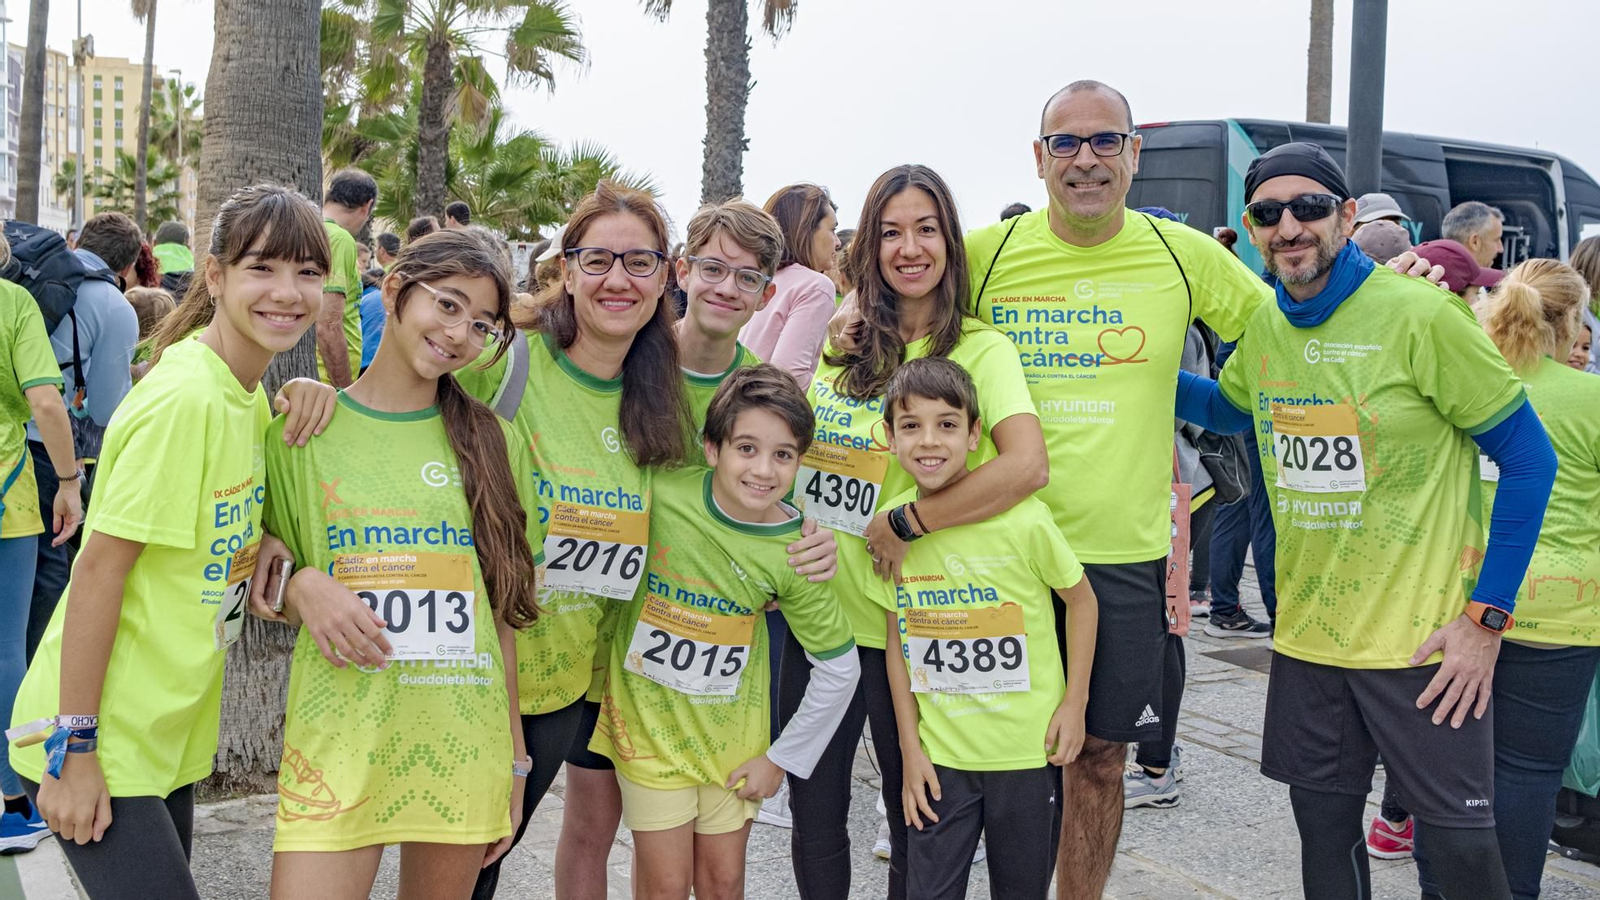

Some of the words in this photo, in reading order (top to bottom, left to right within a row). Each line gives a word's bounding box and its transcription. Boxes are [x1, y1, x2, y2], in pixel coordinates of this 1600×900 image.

[992, 305, 1018, 325] En
[1026, 305, 1123, 324] marcha
[1006, 327, 1068, 345] ontra
[1020, 348, 1105, 368] cáncer
[1041, 400, 1115, 413] HYUNDAI
[1259, 392, 1270, 411] En
[814, 404, 852, 428] ntra
[1089, 416, 1115, 424] Motor
[1280, 434, 1357, 472] 2028
[560, 486, 643, 511] marcha
[805, 470, 875, 517] 4390
[215, 501, 241, 529] En
[590, 511, 617, 520] marcha
[1293, 500, 1362, 516] HYUNDAI
[554, 513, 580, 522] contra
[581, 516, 588, 524] el
[589, 518, 614, 527] cáncer
[327, 525, 356, 550] En
[364, 520, 474, 547] marcha
[337, 556, 364, 565] Cádiz
[380, 554, 417, 563] marcha
[338, 565, 368, 574] contra
[371, 564, 379, 572] el
[382, 563, 415, 572] cáncer
[546, 538, 643, 580] 2016
[203, 557, 232, 582] el
[919, 574, 945, 582] MARCHA
[648, 572, 670, 597] En
[675, 587, 753, 617] marcha
[897, 586, 913, 608] En
[917, 583, 998, 607] marcha
[356, 590, 470, 634] 2013
[646, 603, 672, 617] contra
[672, 614, 681, 622] el
[681, 617, 709, 629] cáncer
[671, 606, 681, 614] en
[682, 610, 712, 623] marcha
[941, 618, 968, 626] cáncer
[642, 629, 745, 677] 2015
[923, 636, 1023, 673] 4389
[399, 674, 465, 685] Guadalete
[466, 675, 493, 686] Motor
[1135, 716, 1160, 727] adidas
